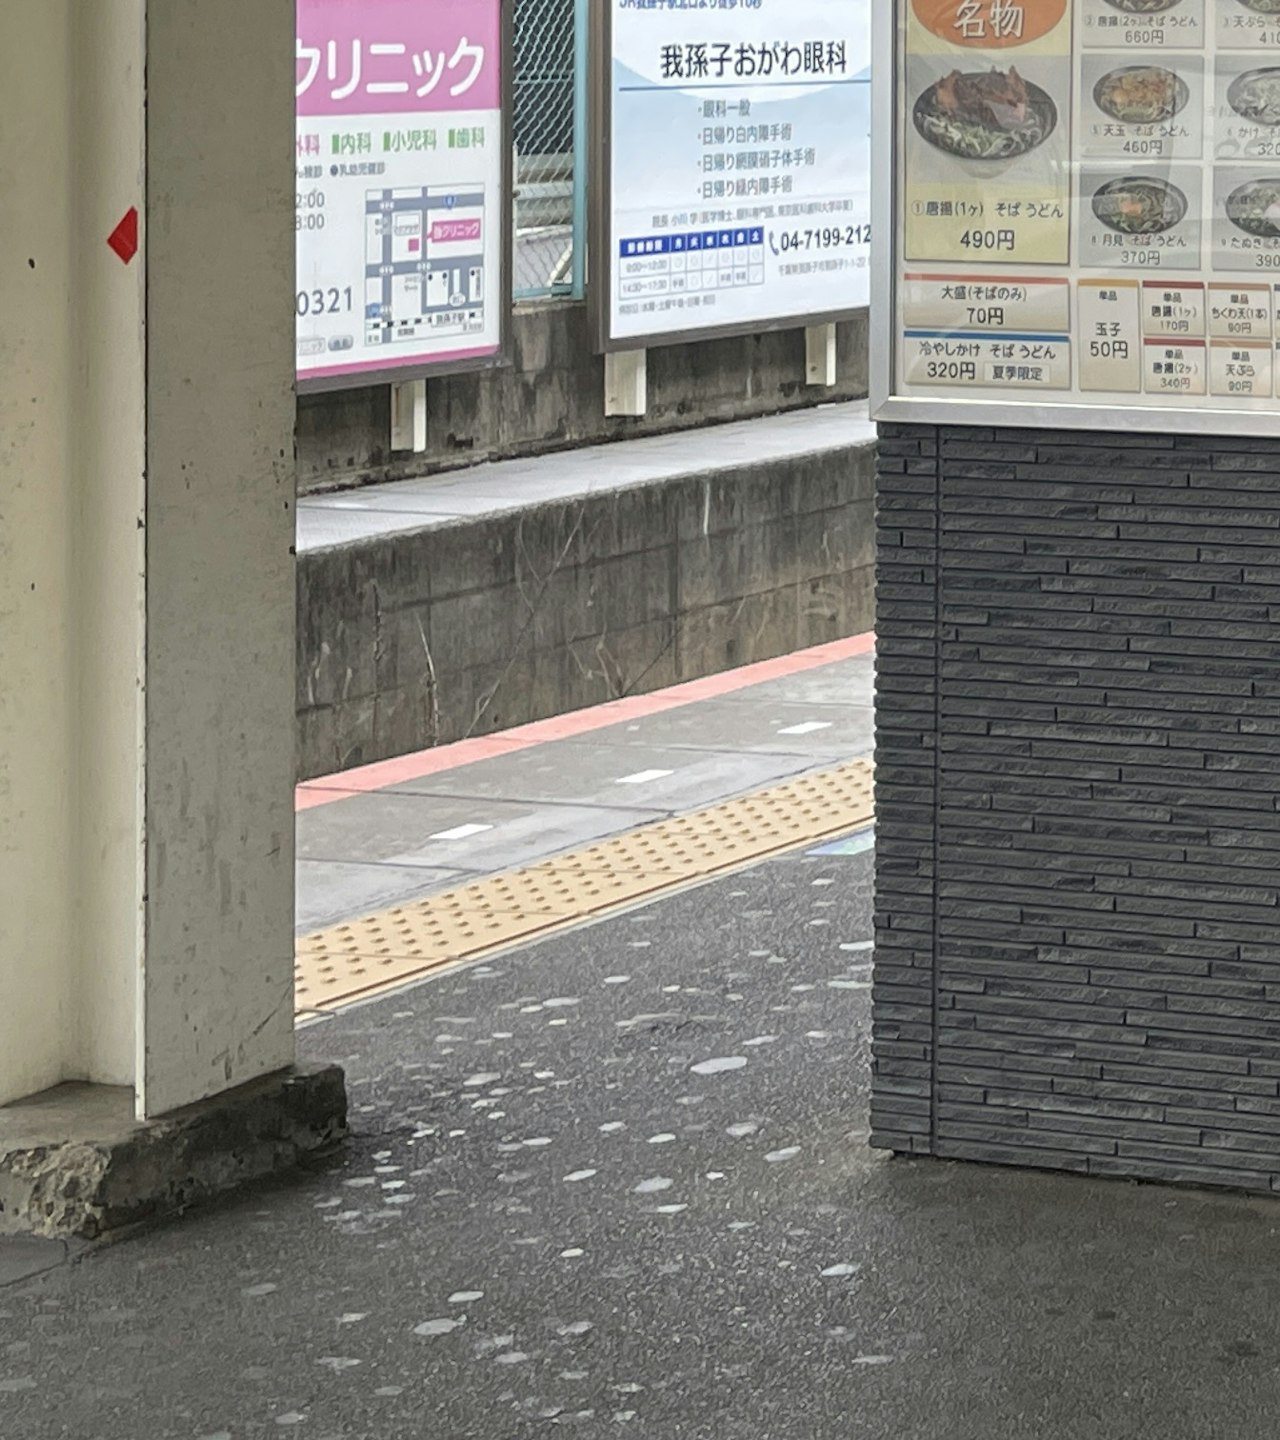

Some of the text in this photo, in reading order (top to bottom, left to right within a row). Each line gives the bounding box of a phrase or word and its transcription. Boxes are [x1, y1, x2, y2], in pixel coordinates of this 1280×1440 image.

[953, 0, 1024, 39] 名物
[1169, 15, 1198, 28] うどん
[1125, 29, 1164, 45] 660円
[295, 36, 485, 100] クリニック
[660, 40, 847, 79] 我孫子おがわ眼科
[391, 129, 438, 152] 小児科
[456, 126, 485, 148] 歯科
[1159, 125, 1190, 138] うどん
[1122, 139, 1163, 155] 460円
[994, 202, 1021, 218] そば
[1026, 202, 1064, 219] うどん
[959, 229, 1016, 251] 490円
[1102, 233, 1124, 247] 月見
[1156, 234, 1187, 248] うどん
[1121, 250, 1161, 266] 370円
[296, 286, 353, 317] 0321
[941, 285, 1028, 302] 大盛(そばのみ)
[966, 307, 1004, 325] 70円
[1095, 322, 1121, 337] 玉子
[919, 340, 1057, 360] 冷やしかけ そば うどん
[1089, 340, 1129, 360] 50円
[926, 361, 1043, 381] 320円 夏季限定
